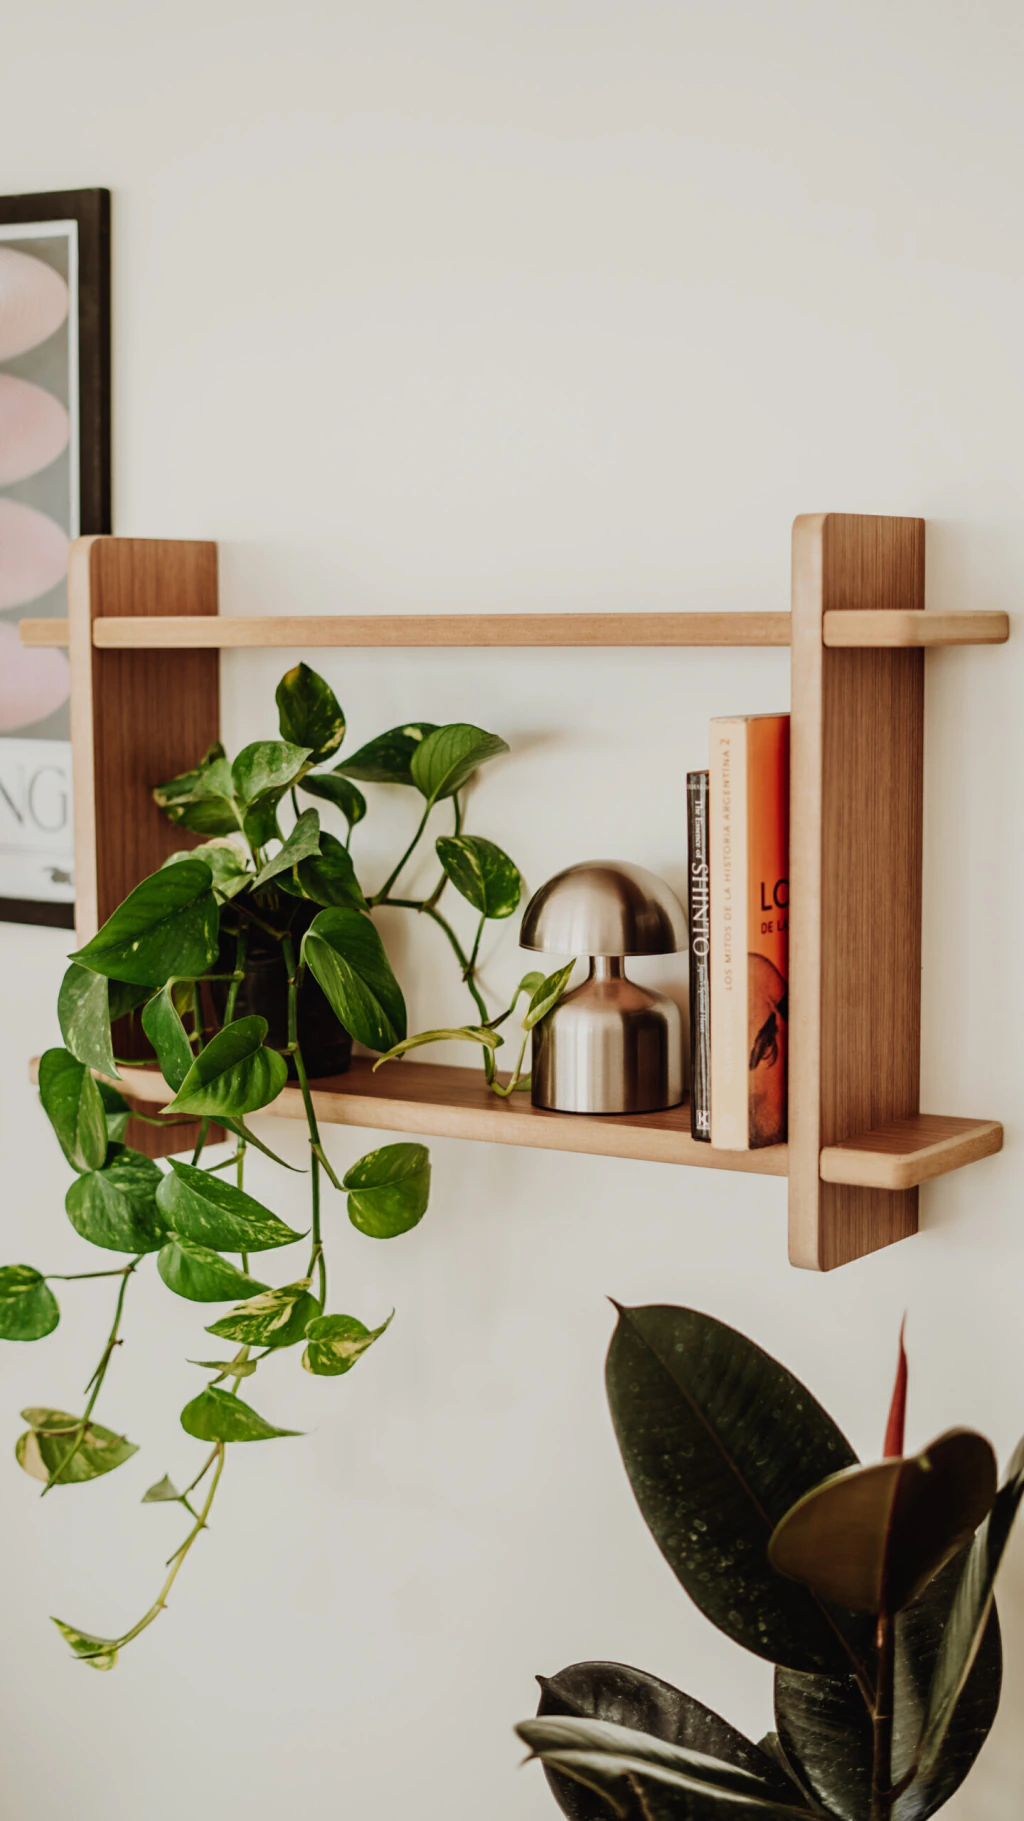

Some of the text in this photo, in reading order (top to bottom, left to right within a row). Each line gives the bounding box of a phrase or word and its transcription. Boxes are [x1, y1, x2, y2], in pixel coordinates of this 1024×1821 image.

[694, 800, 703, 816] The
[694, 817, 703, 848] Essence
[694, 849, 703, 860] of
[720, 738, 732, 991] LOS MITOS DE LA HISTORIA ARGENTINA 2
[691, 863, 709, 956] SHINTO
[761, 921, 773, 935] DE
